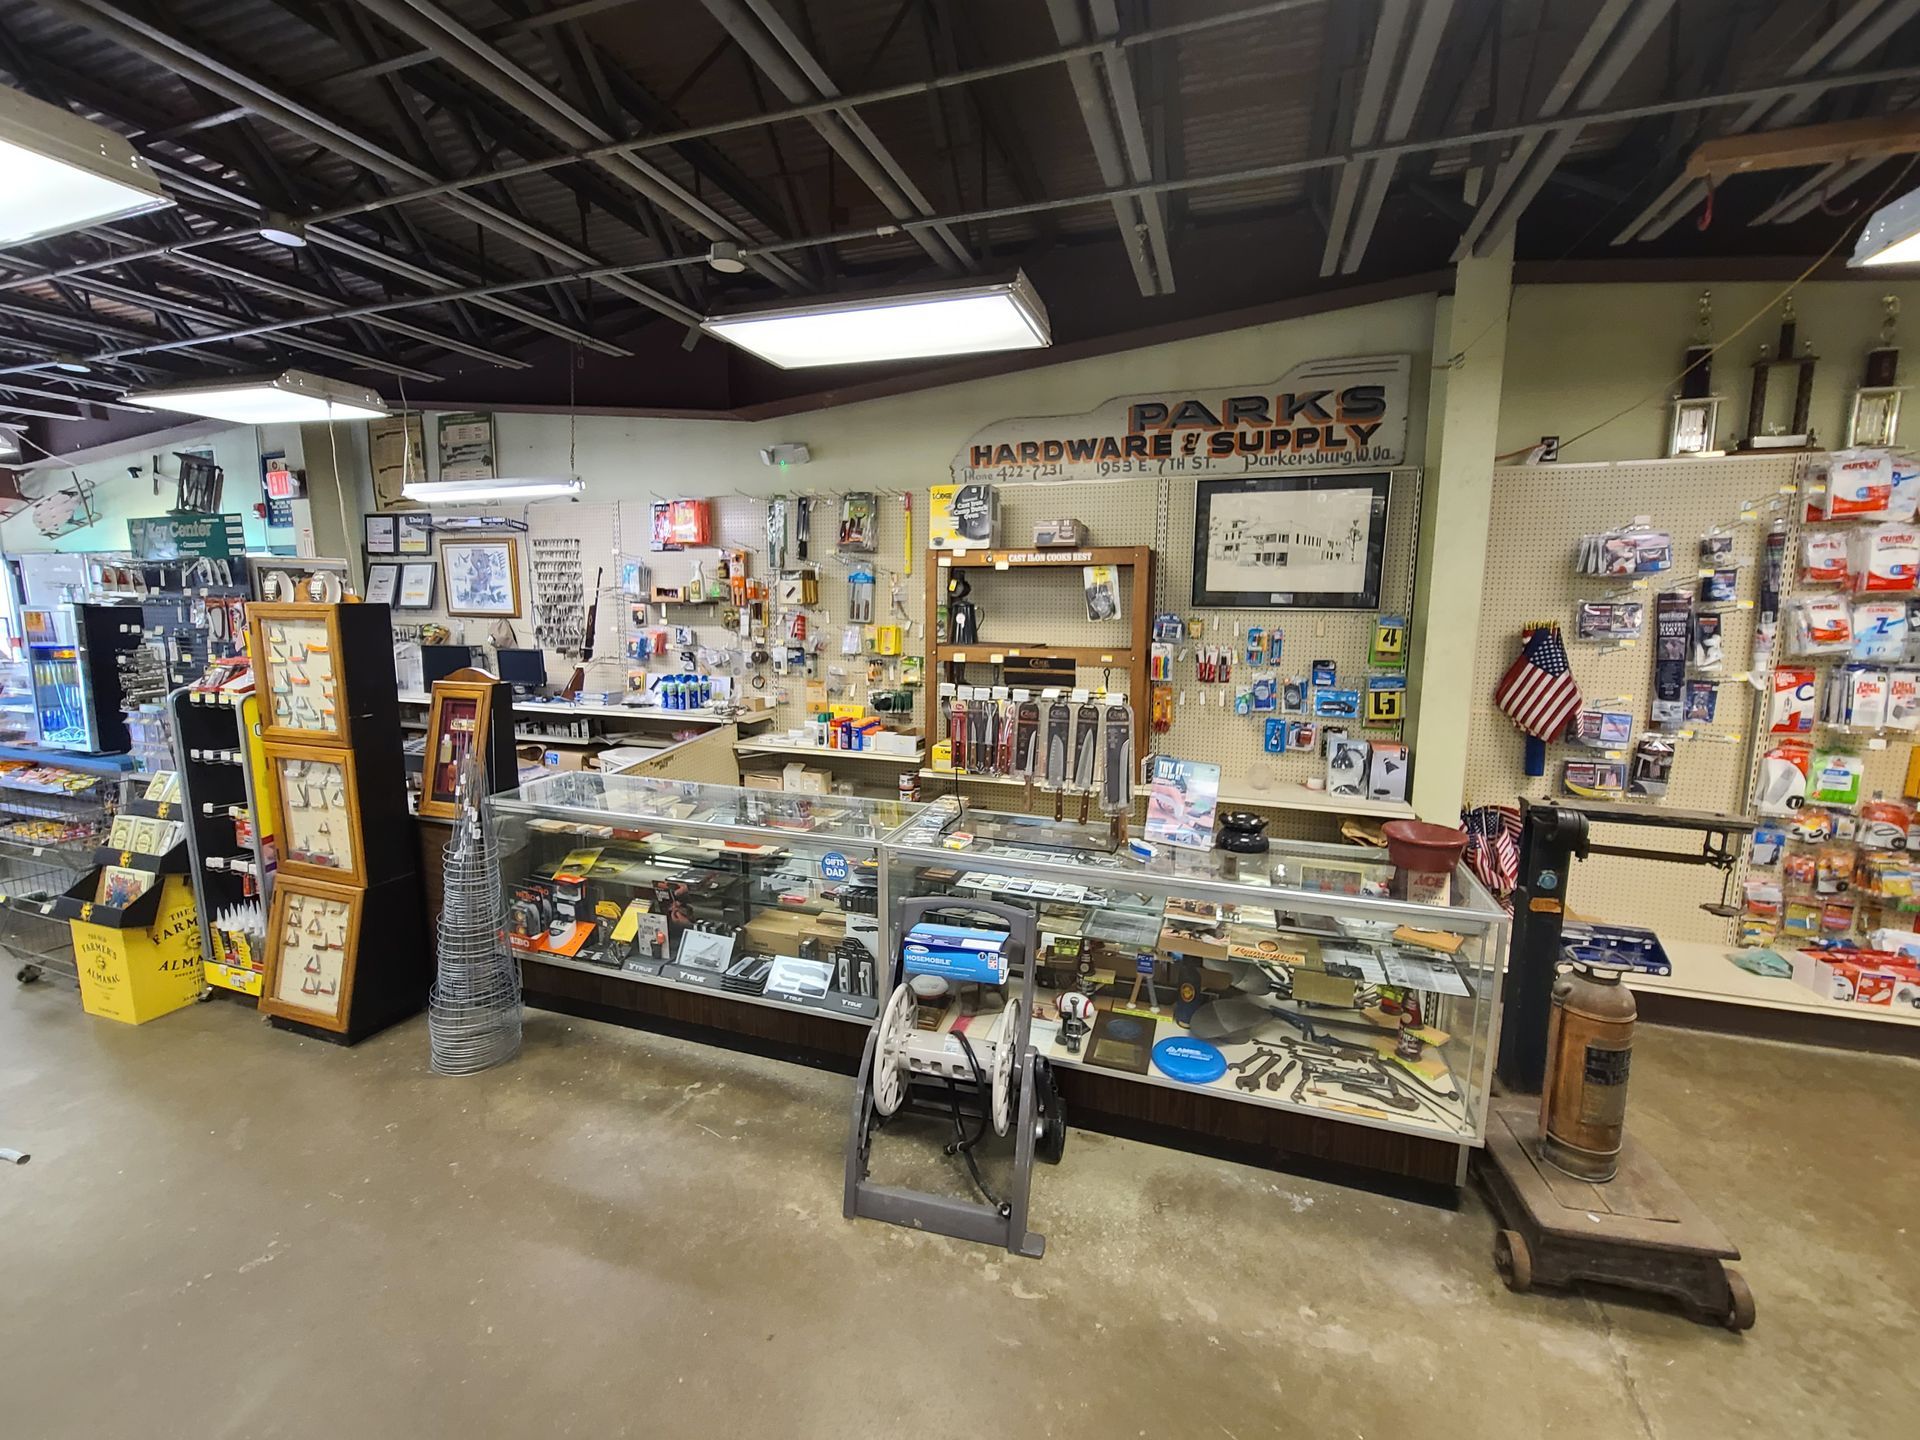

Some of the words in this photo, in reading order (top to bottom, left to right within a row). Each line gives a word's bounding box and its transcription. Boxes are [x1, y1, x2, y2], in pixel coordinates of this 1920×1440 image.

[1128, 385, 1387, 435] PARKS
[970, 434, 1173, 469] HARDWARE
[1181, 432, 1200, 456] &
[1207, 422, 1382, 459] SUPPLY
[996, 463, 1063, 482] 422-7231
[1096, 460, 1132, 476] 1953
[1157, 457, 1185, 474] 7TH
[1191, 455, 1216, 470] ST.
[147, 521, 167, 541] Key
[169, 520, 212, 537] Center
[1009, 553, 1026, 563] CAST
[1047, 552, 1072, 562] COOKS
[1073, 551, 1093, 561] BEST
[1876, 617, 1889, 634] Z
[1383, 629, 1398, 647] 4
[1795, 682, 1815, 702] C
[1158, 760, 1174, 775] TRY
[825, 859, 845, 867] GIFTS
[826, 867, 846, 877] DAD
[1413, 874, 1446, 888] ACE
[169, 908, 191, 921] THE
[152, 916, 198, 946] FARM
[158, 955, 203, 972] ALMA
[906, 954, 952, 966] HOSEMOBILE
[87, 967, 121, 984] ALMANAC
